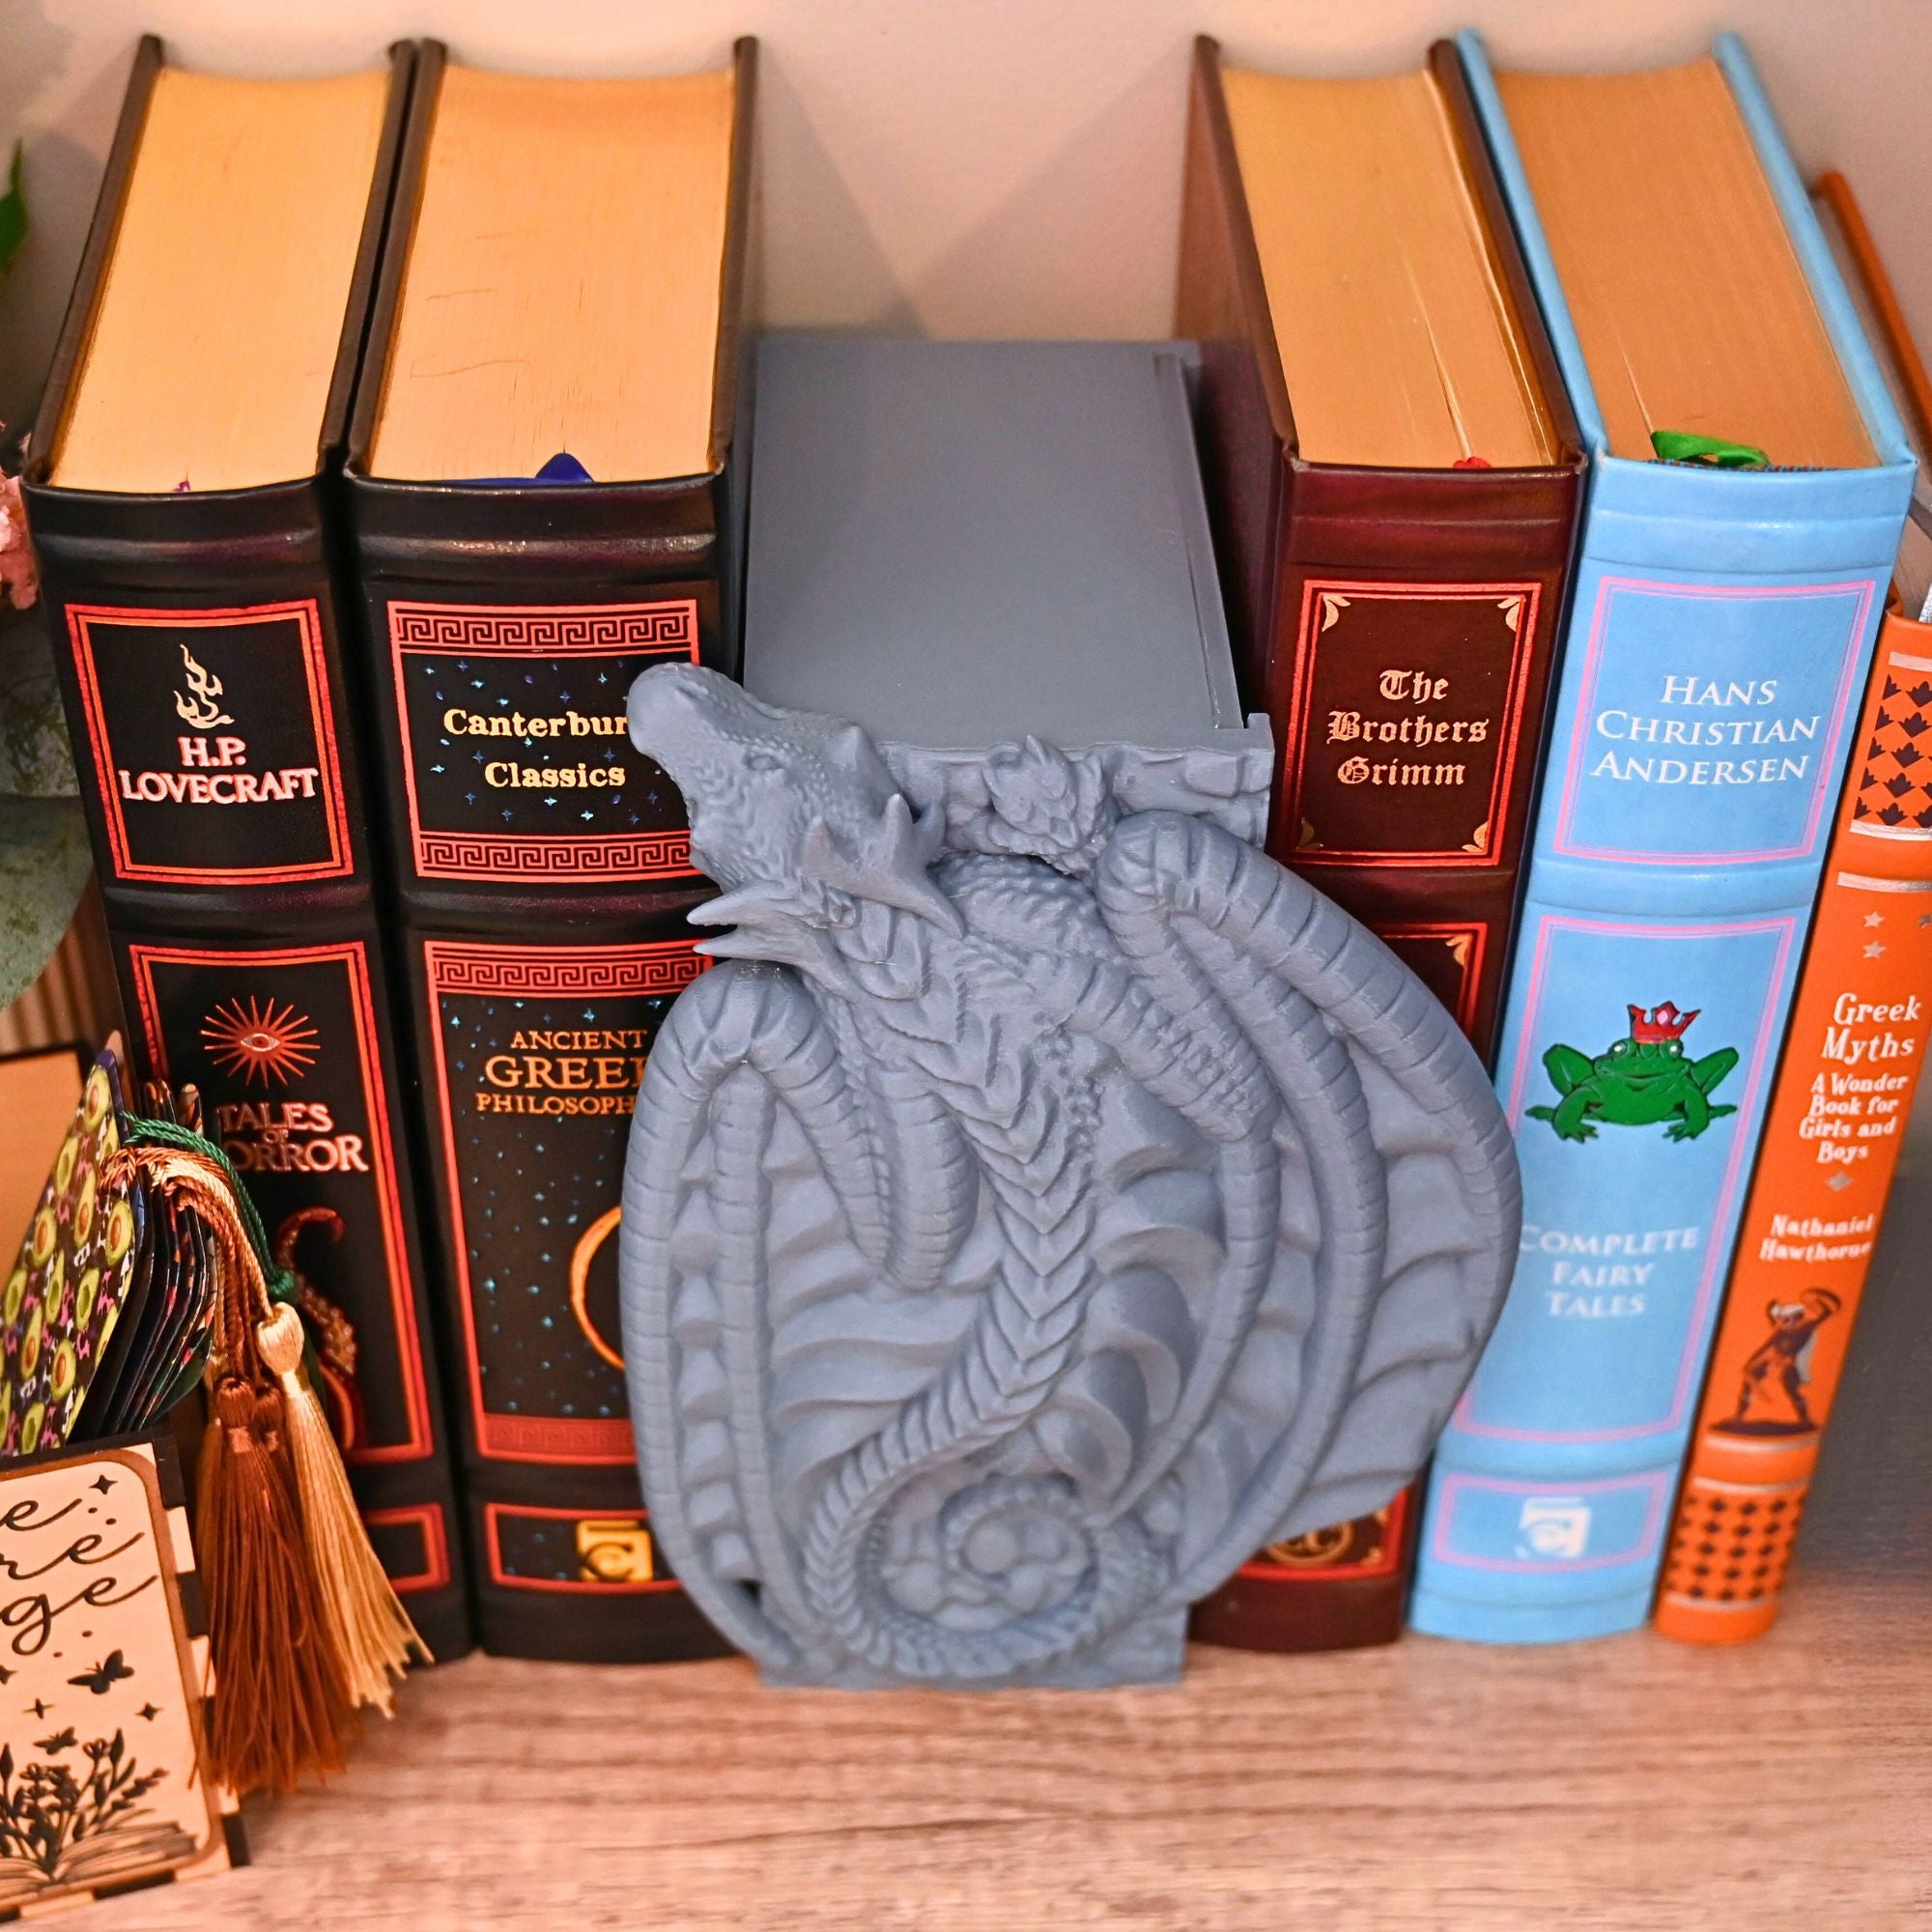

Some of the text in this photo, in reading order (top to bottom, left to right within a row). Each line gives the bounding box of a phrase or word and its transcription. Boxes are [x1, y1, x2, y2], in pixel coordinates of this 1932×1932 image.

[1379, 669, 1449, 704] The
[1659, 675, 1778, 706] HANS
[443, 708, 627, 737] Canterbur
[1326, 711, 1490, 748] Brothers
[1596, 710, 1822, 746] CHRISTIAN
[178, 736, 247, 767] H.P.
[485, 761, 626, 788] Classics
[1337, 755, 1466, 786] Grimm
[1590, 750, 1810, 785] ANDERSEN
[118, 767, 319, 805] LOVECRAFT
[1833, 992, 1921, 1026] Greek
[510, 1030, 648, 1051] ANCIENT
[1821, 1026, 1915, 1065] Myths
[1810, 1071, 1909, 1095] A Wonder
[217, 1101, 334, 1133] TALES
[475, 1093, 638, 1115] PHILOSOPH
[1808, 1094, 1899, 1118] Book for
[1799, 1116, 1897, 1140] Girls and
[223, 1134, 369, 1173] ORROR
[1816, 1140, 1869, 1165] Boys
[1769, 1213, 1874, 1238] Nathaniel
[1759, 1237, 1872, 1264] Hawthorne
[1552, 1260, 1655, 1288] FAIRY
[1547, 1291, 1647, 1318] TALES
